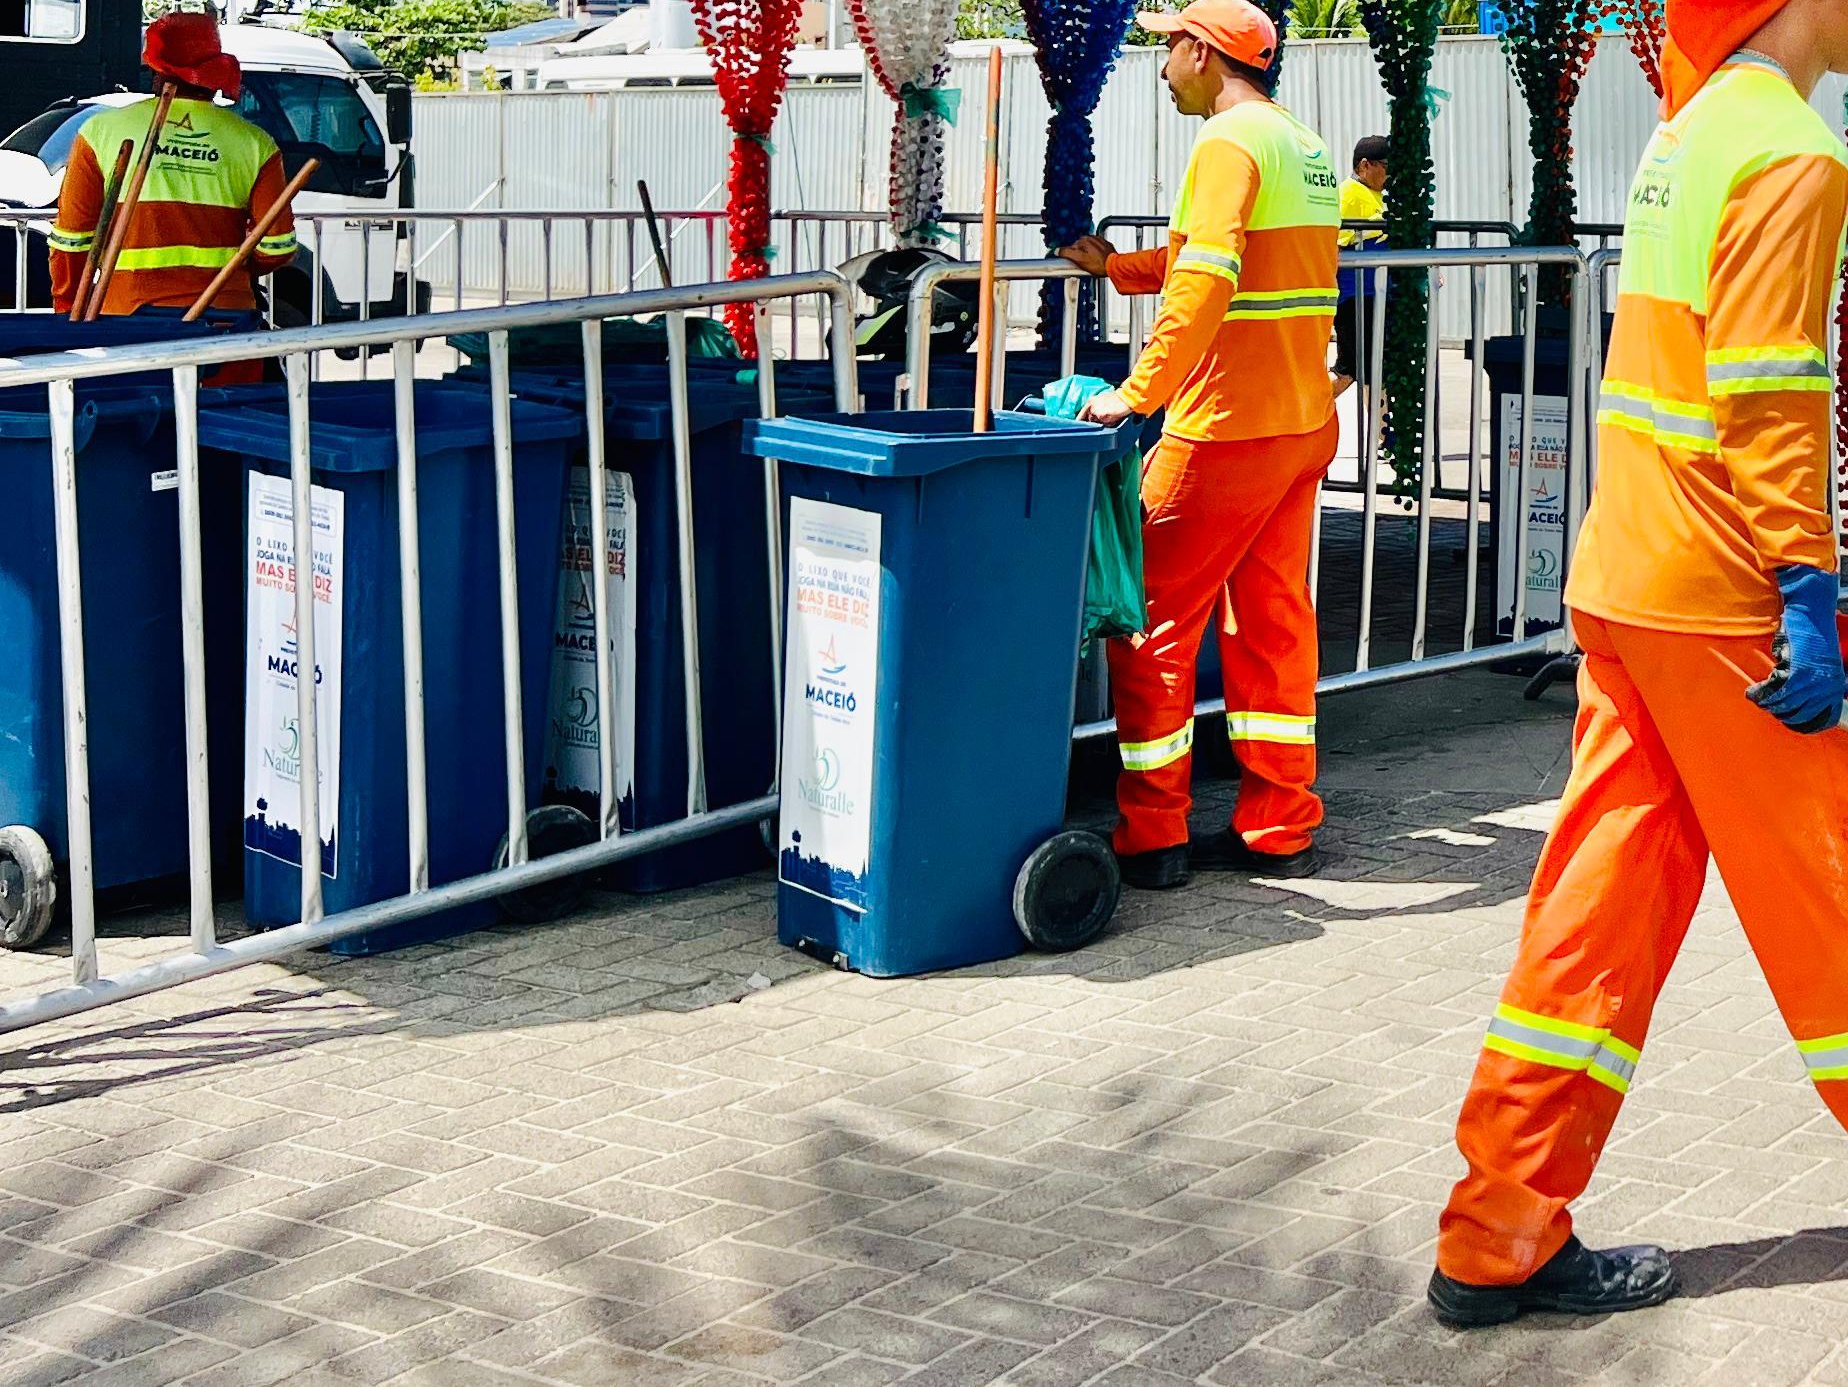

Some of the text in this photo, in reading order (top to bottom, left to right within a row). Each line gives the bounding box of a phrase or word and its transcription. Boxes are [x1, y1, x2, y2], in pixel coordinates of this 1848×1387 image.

[154, 143, 219, 162] MACEIÓ
[256, 561, 284, 579] MAS
[315, 576, 332, 594] DIZ
[828, 593, 849, 612] ELE
[805, 683, 856, 712] MACEIÓ
[798, 777, 854, 815] Naturalle
